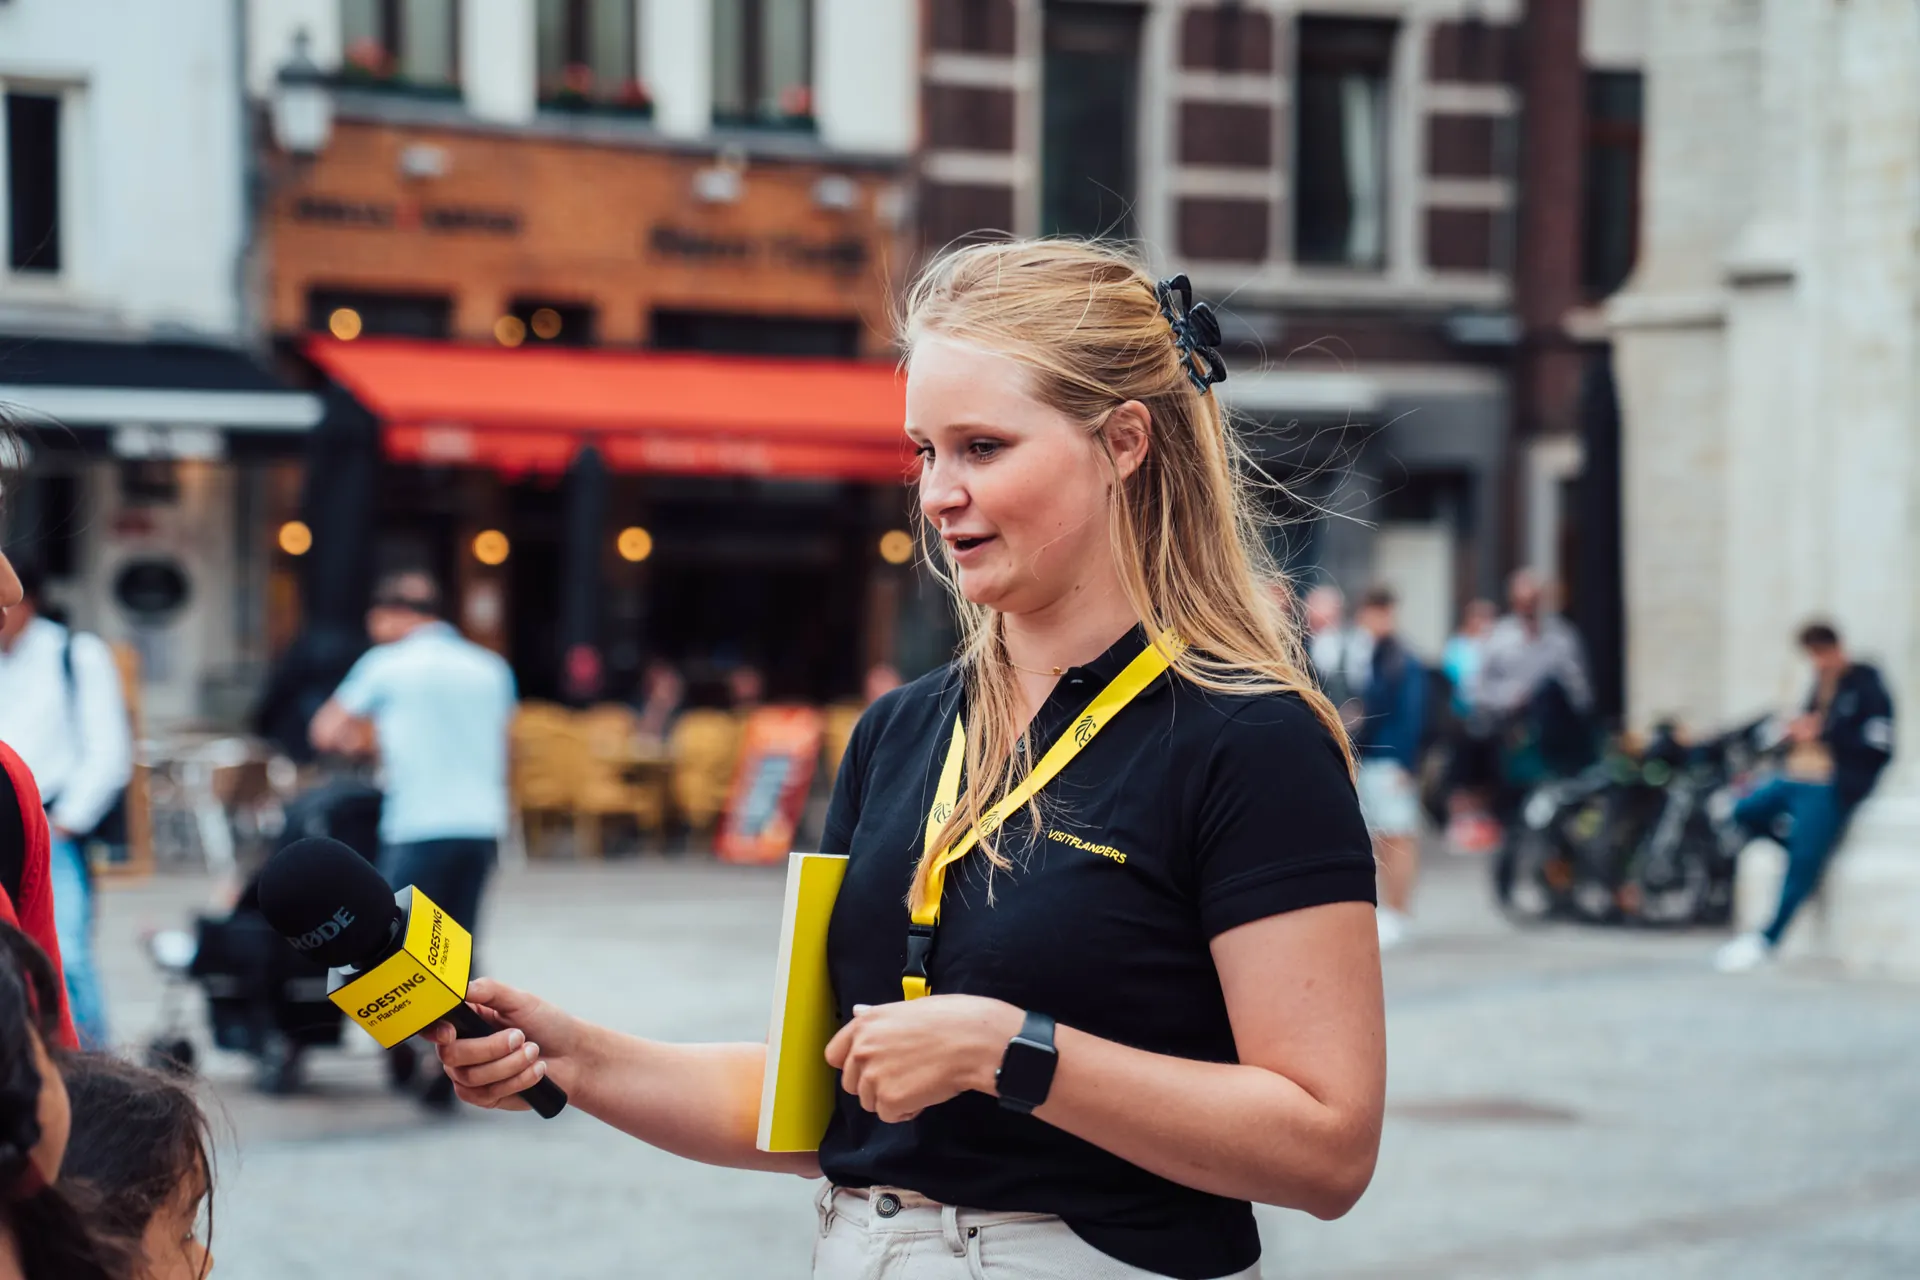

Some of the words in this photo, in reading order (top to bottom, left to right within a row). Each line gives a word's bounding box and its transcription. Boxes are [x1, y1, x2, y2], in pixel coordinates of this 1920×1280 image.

[1047, 828, 1127, 864] VISITFLANDERS
[427, 908, 443, 966] GOESTING
[440, 937, 450, 966] Flanders
[357, 972, 427, 1019] GOESTING
[367, 1019, 378, 1028] in
[376, 999, 412, 1022] Flanders
